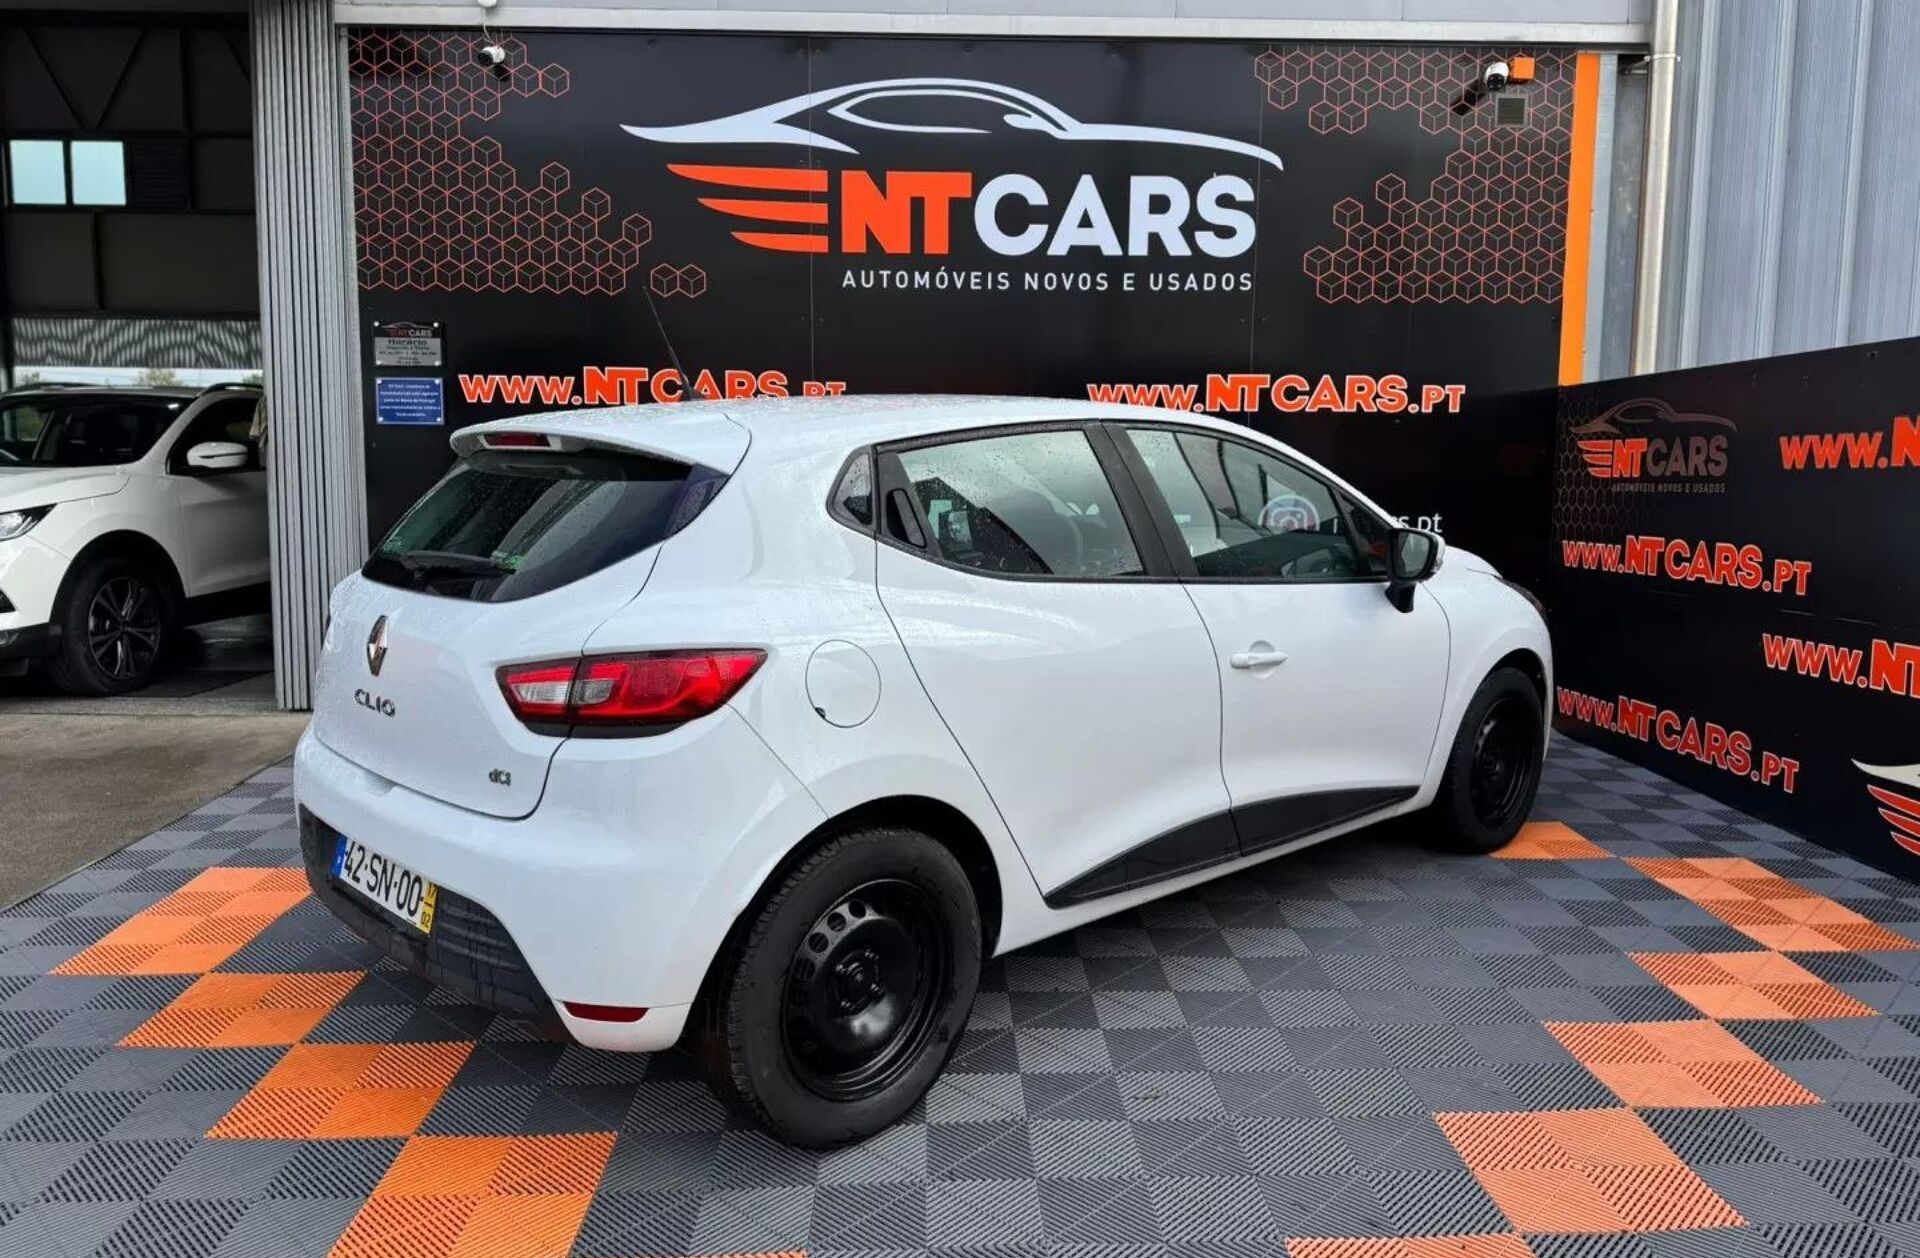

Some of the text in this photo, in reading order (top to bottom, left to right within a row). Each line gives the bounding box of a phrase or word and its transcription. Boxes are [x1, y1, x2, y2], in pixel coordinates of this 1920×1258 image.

[841, 170, 1257, 258] NTCARS
[842, 267, 1253, 291] AUTOMÓVEIS NOVOS E USADOS
[354, 688, 396, 717] CLIO
